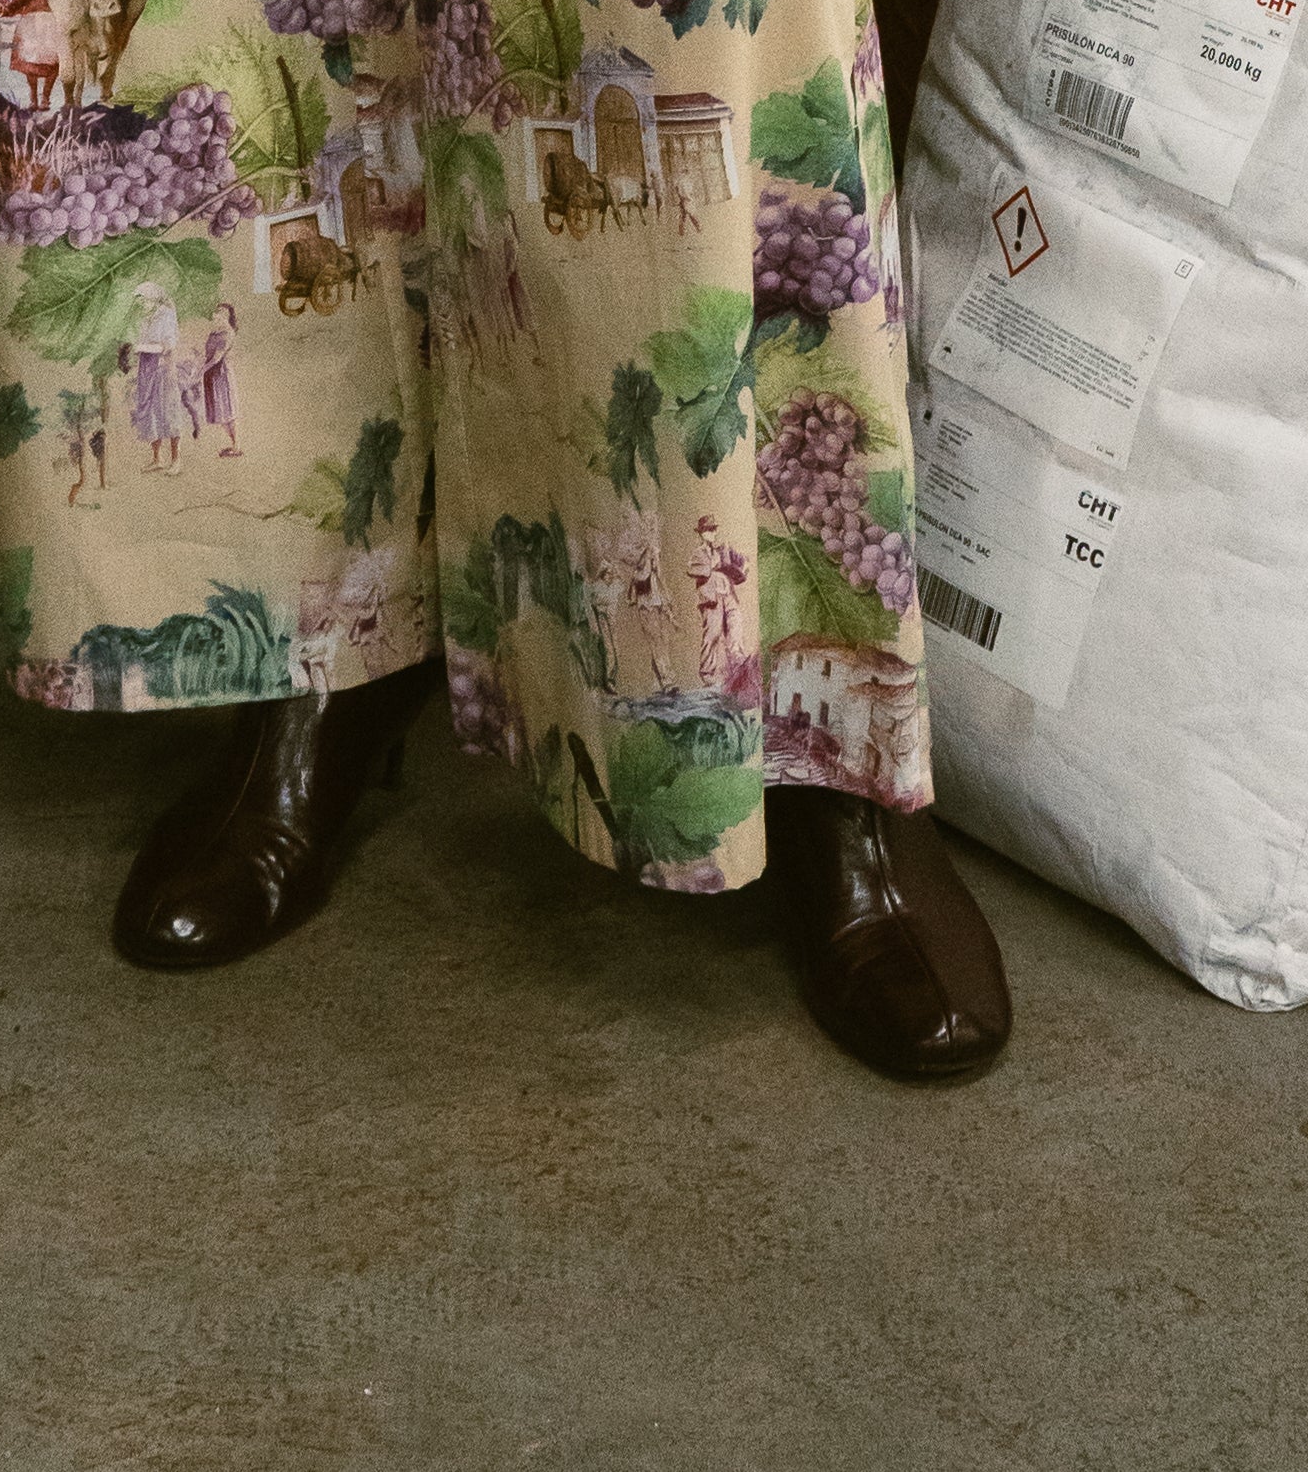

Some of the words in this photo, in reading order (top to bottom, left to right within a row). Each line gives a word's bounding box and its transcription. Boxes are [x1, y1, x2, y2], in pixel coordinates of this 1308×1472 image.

[1045, 23, 1097, 52] PRISULON
[1096, 42, 1120, 63] DCA
[1122, 53, 1136, 67] 90
[1200, 44, 1242, 72] 20,000
[1244, 59, 1263, 83] kg
[1077, 489, 1120, 523] CHT
[1064, 533, 1105, 569] TCC
